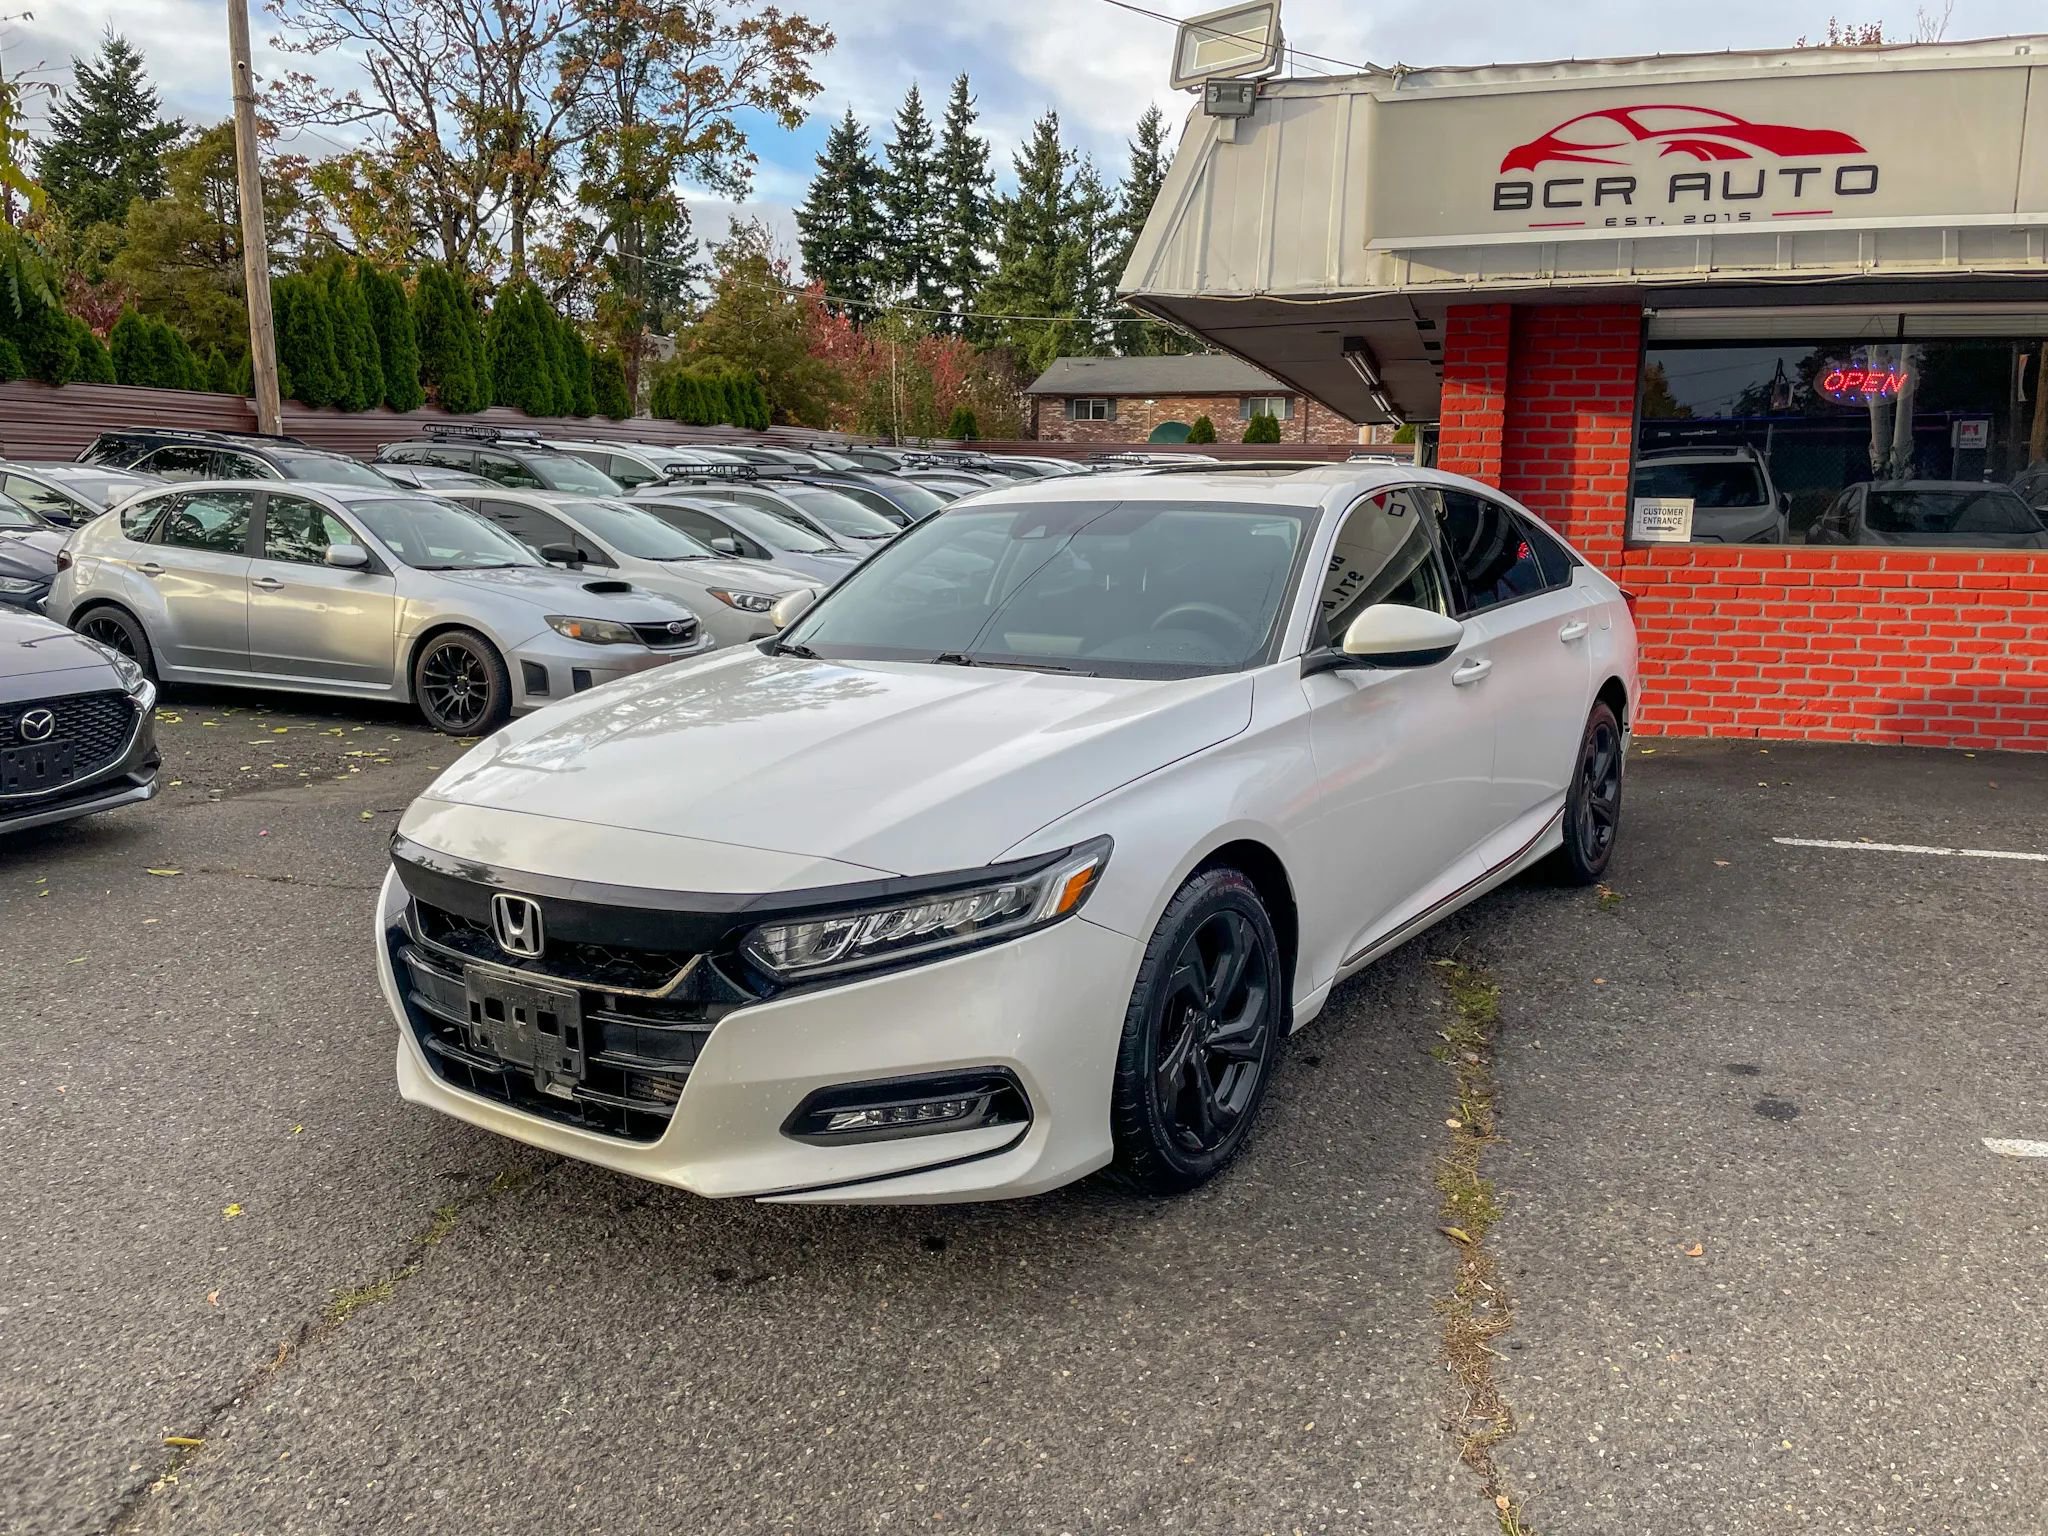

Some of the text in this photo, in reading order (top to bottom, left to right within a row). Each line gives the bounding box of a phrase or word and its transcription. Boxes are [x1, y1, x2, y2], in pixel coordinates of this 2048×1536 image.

[1494, 165, 1880, 211] BCR AUTO
[1605, 212, 1752, 227] EST. 2015
[1824, 372, 1908, 392] OPEN
[1643, 508, 1684, 516] CUSTOMER
[1643, 517, 1682, 525] ENTRANCE
